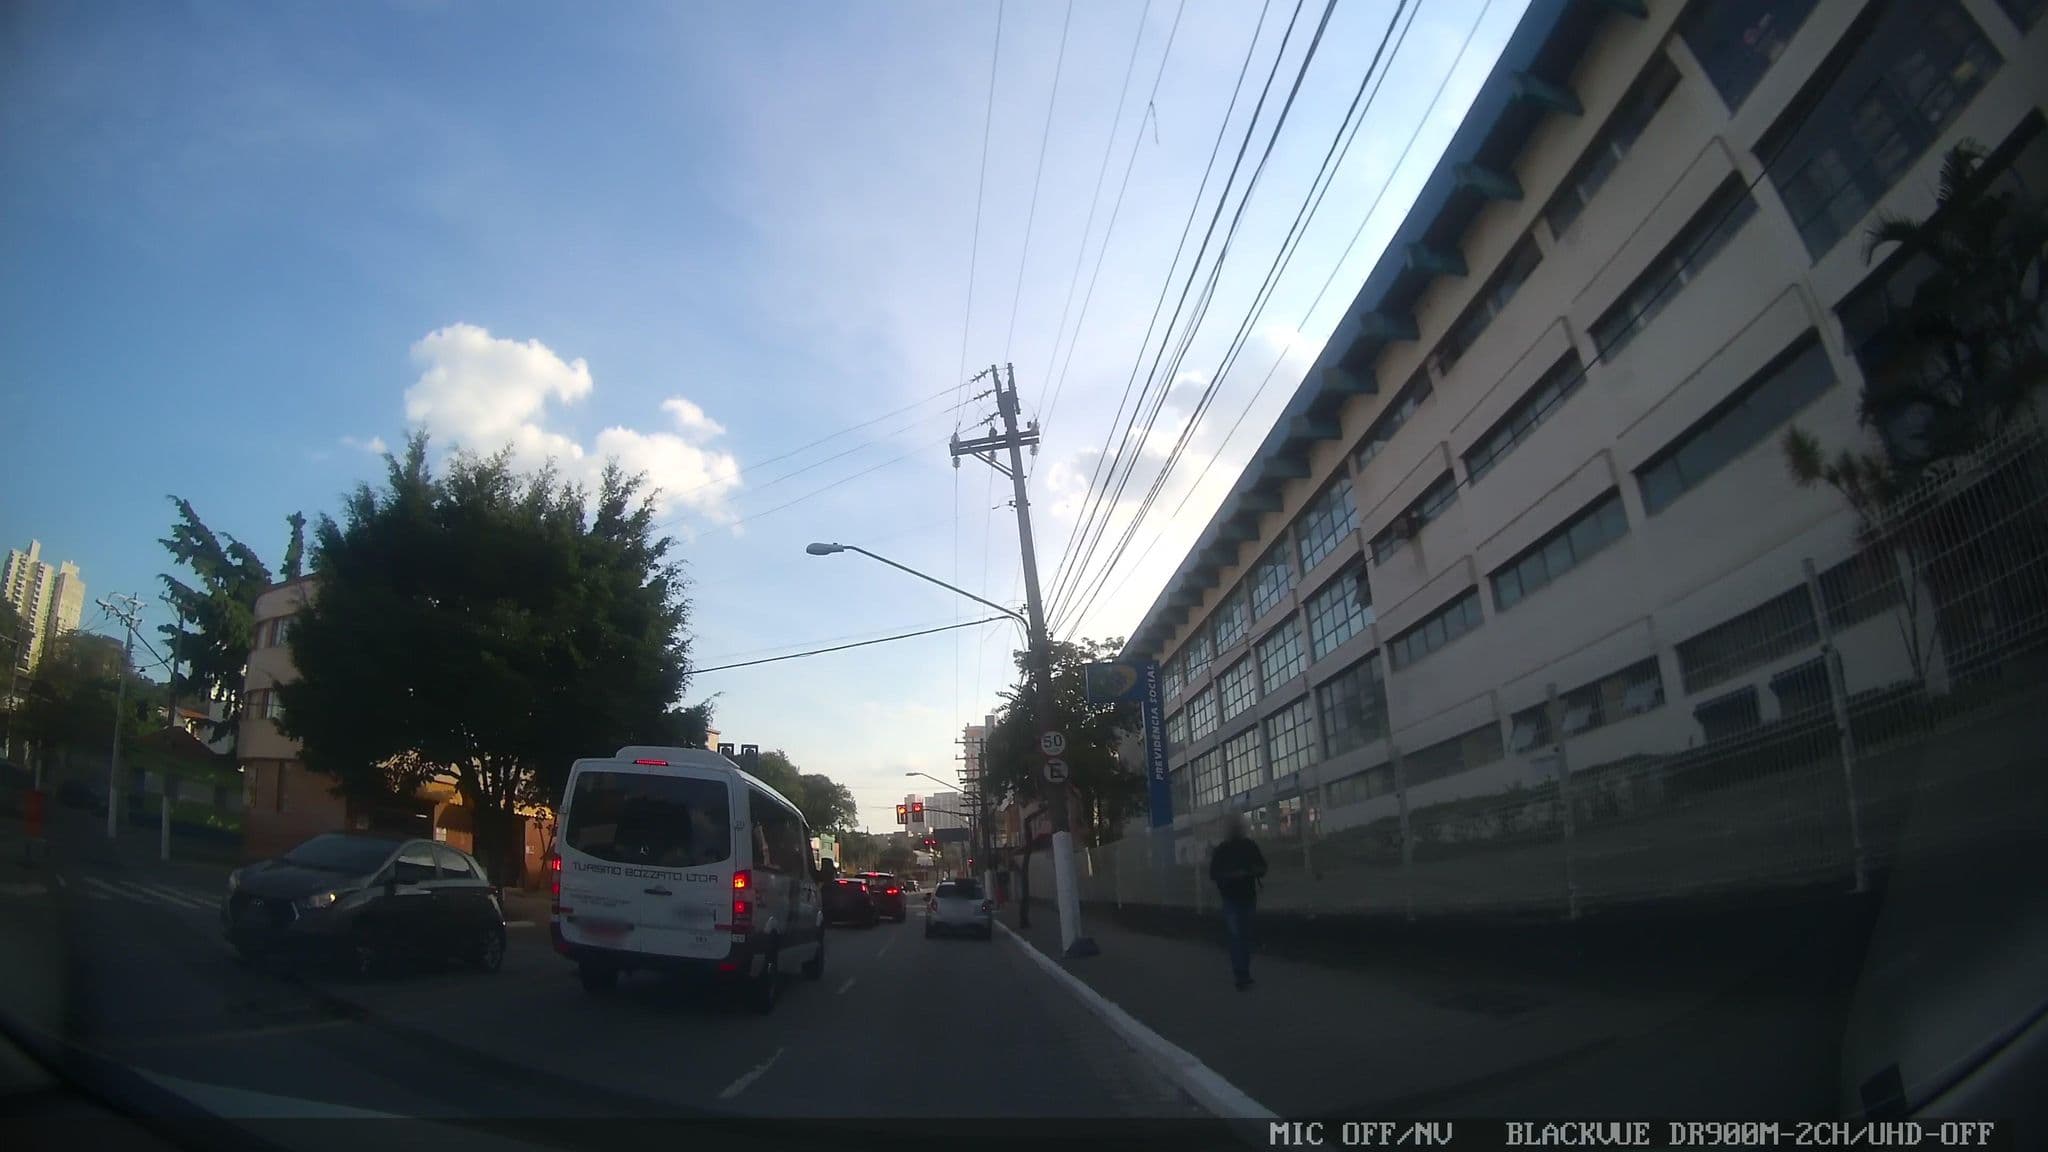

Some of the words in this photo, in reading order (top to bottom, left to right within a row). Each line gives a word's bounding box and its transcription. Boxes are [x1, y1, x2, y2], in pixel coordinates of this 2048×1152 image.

[1147, 664, 1157, 703] SOCIAL
[1043, 735, 1062, 748] 50
[573, 861, 621, 876] TURISMO
[625, 867, 682, 881] BOZZATO
[686, 873, 719, 884] LTDA
